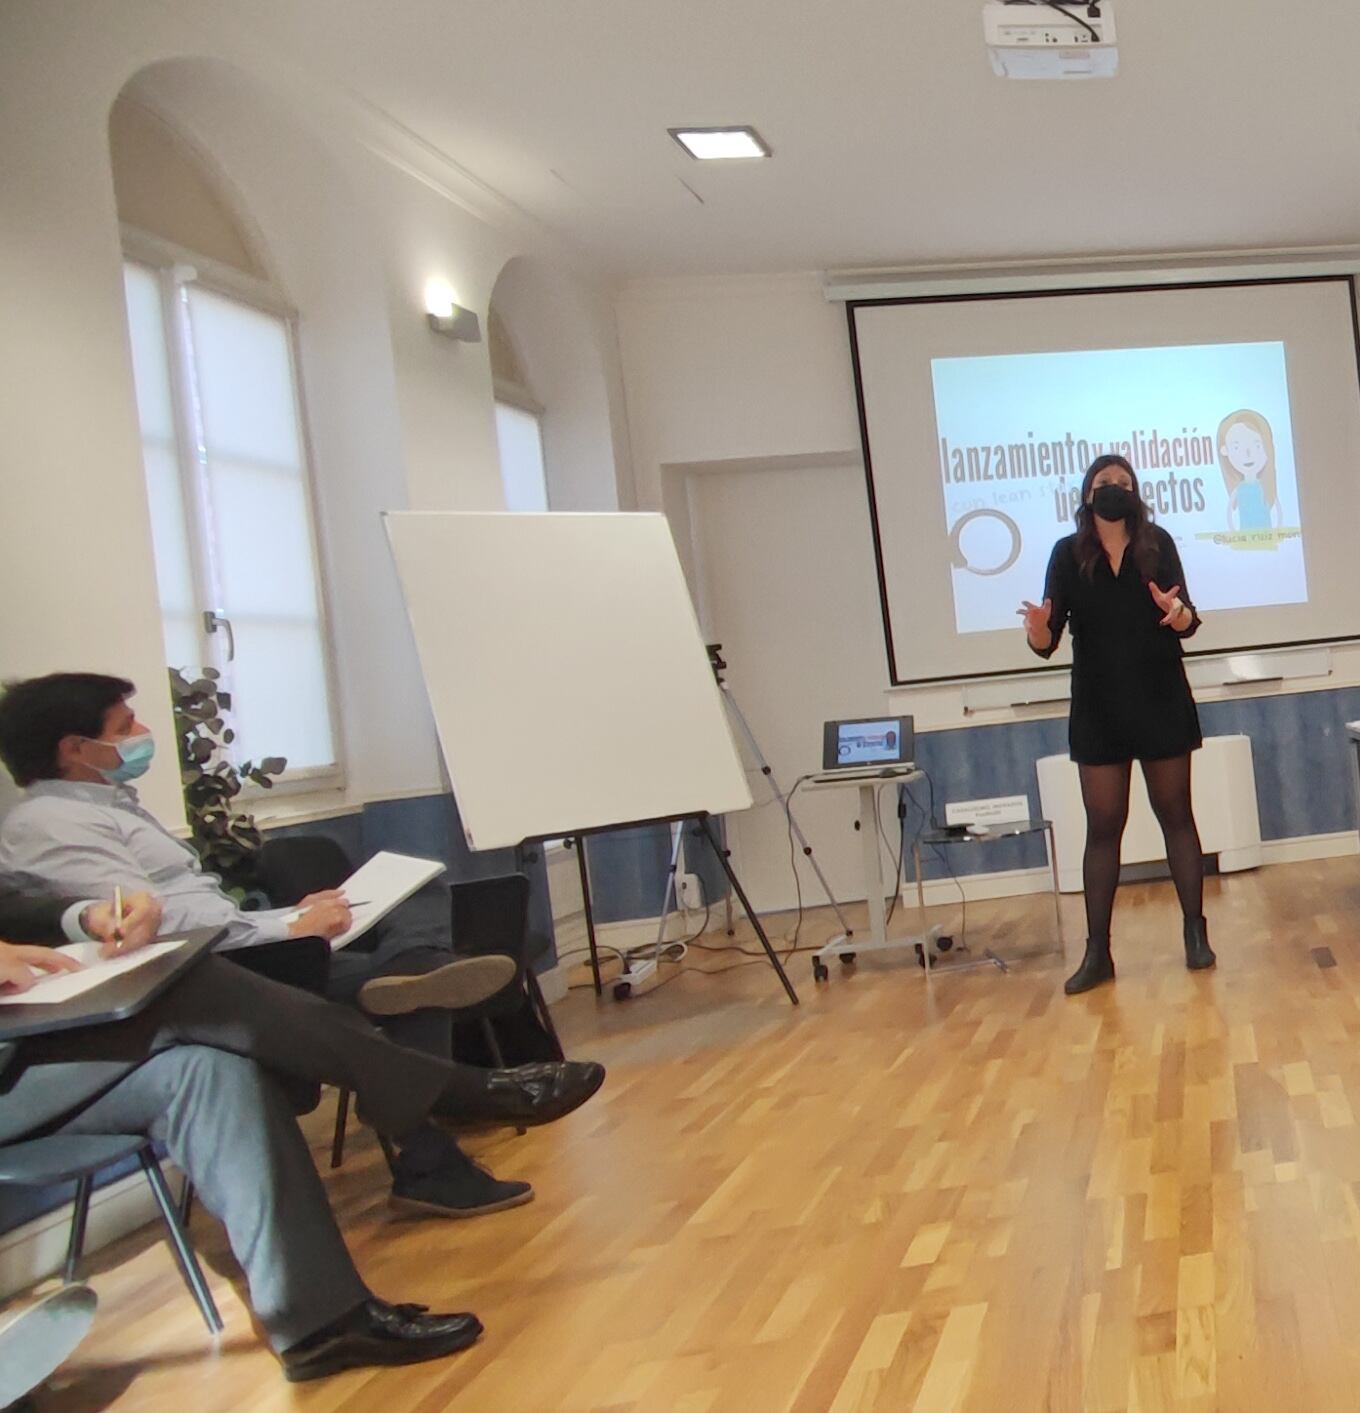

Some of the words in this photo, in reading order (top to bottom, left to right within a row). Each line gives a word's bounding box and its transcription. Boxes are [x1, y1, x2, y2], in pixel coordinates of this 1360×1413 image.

[941, 431, 1090, 483] lanzamiento
[1109, 427, 1214, 469] validación
[1141, 471, 1206, 515] ectos
